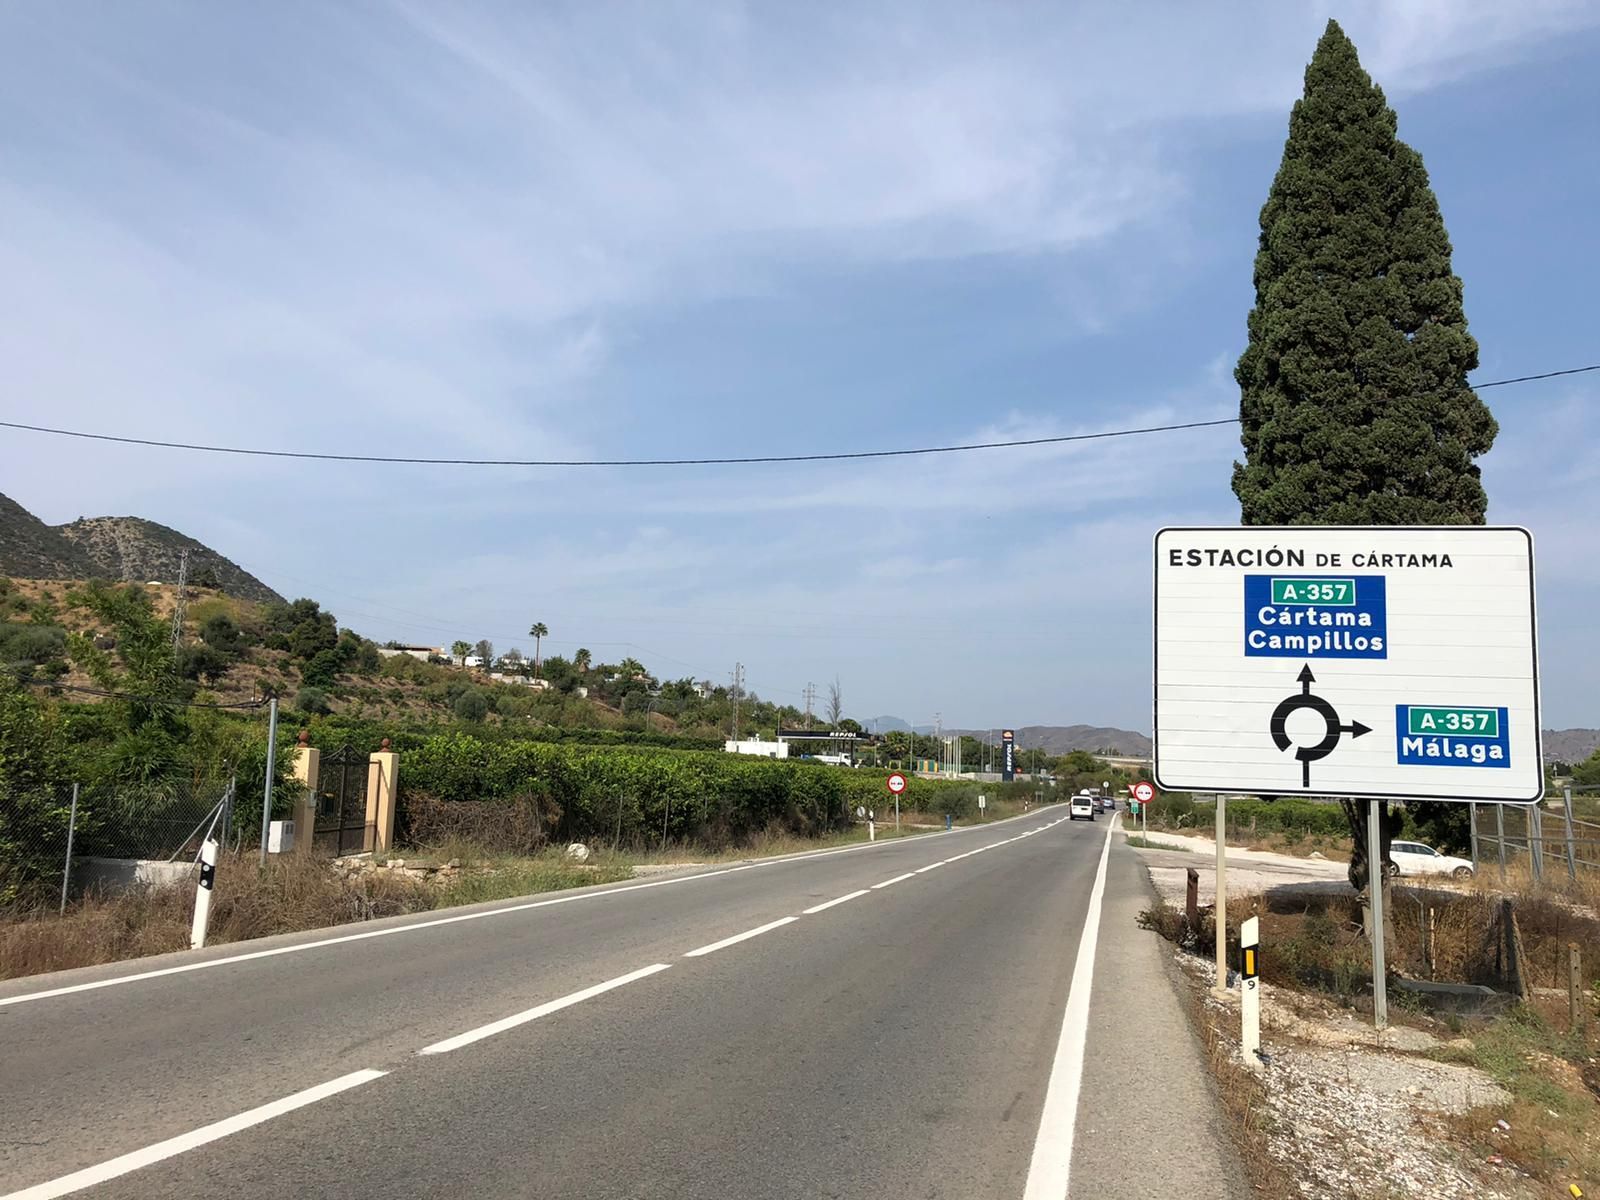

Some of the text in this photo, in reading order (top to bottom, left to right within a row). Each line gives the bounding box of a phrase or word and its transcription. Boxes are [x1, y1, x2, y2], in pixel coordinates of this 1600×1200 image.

[1169, 545, 1453, 568] ESTACIÓN DE CÁRTAMA
[1283, 584, 1347, 600] A-357
[1258, 606, 1372, 626] Cártama
[1248, 630, 1384, 654] Campillos
[1420, 713, 1489, 730] A-357
[1402, 737, 1504, 763] Málaga
[1247, 980, 1256, 990] 9
